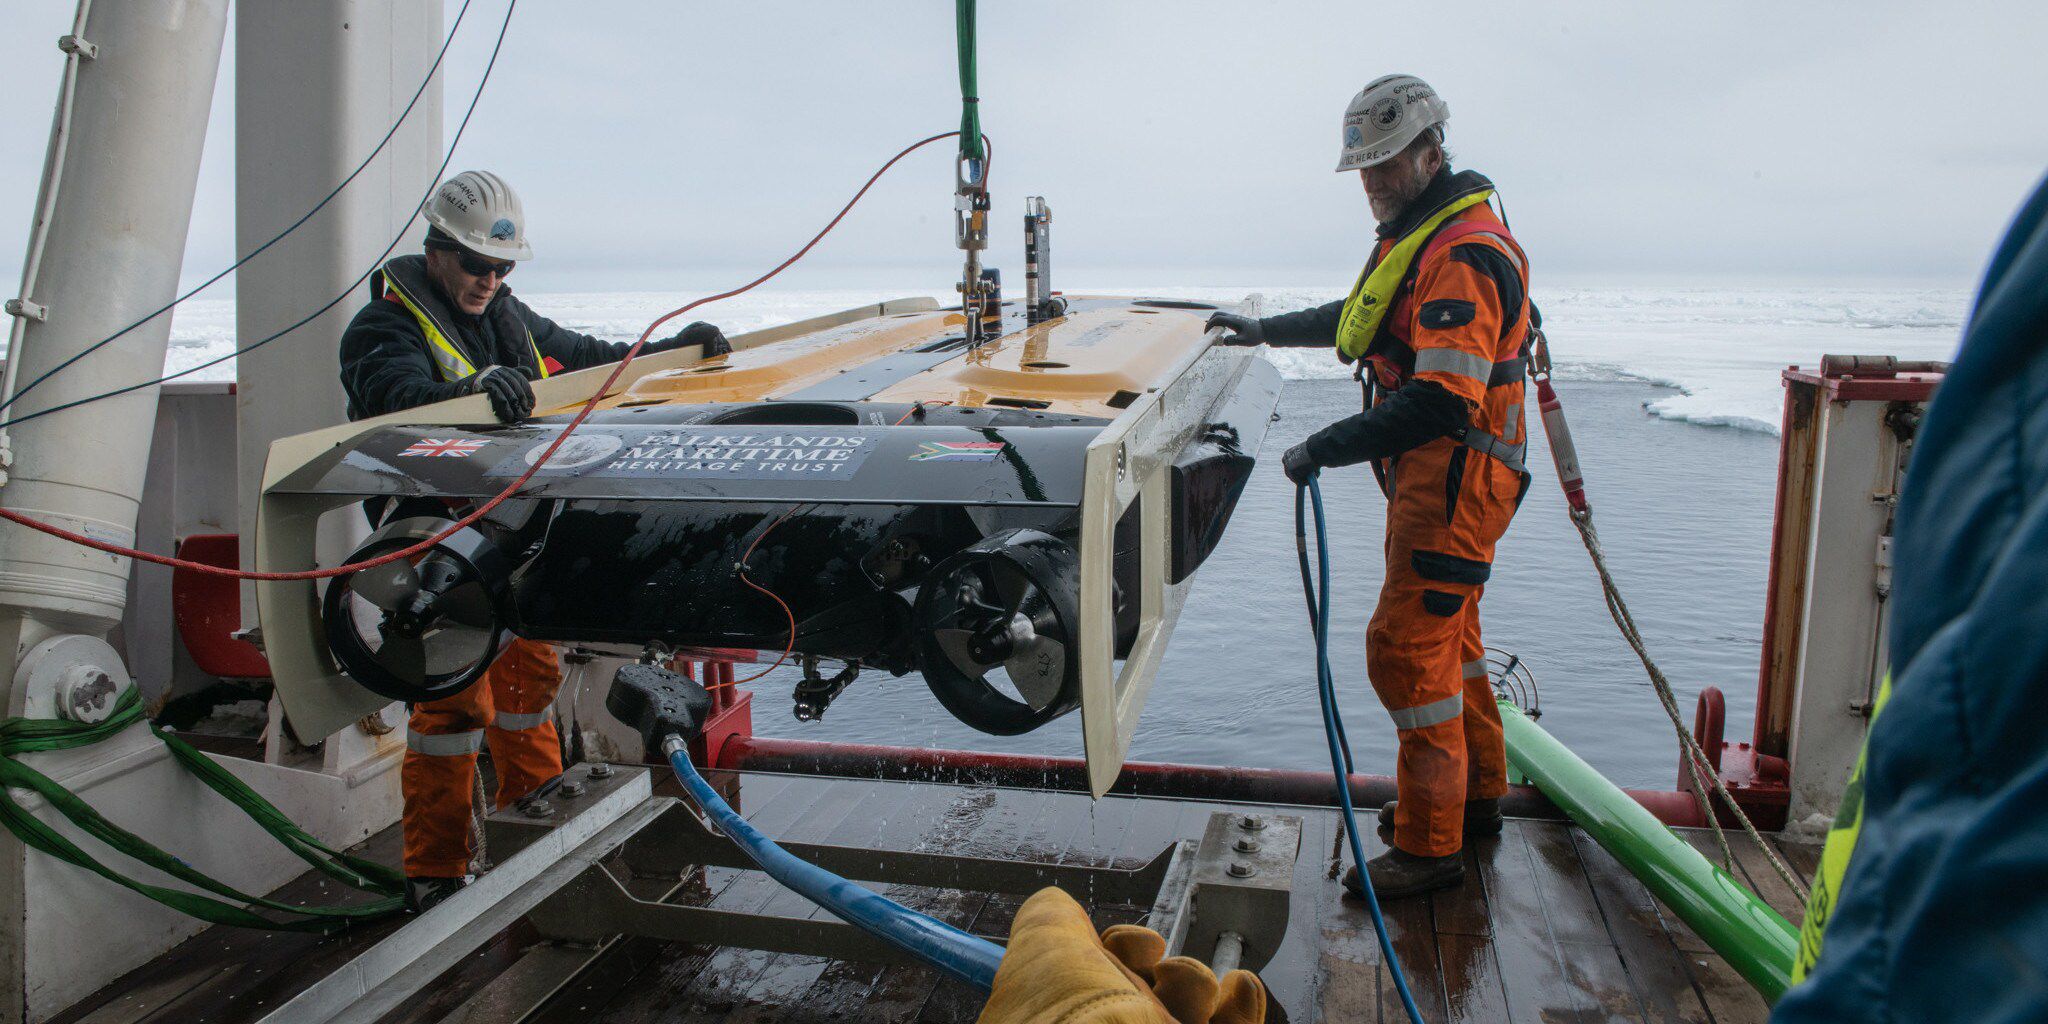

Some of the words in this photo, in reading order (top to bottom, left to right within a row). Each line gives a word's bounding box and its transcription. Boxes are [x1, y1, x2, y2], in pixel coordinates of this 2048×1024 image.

[1356, 150, 1380, 164] HERE
[639, 435, 867, 447] FALKLANDS
[621, 447, 856, 461] MARITIME
[608, 461, 745, 471] HERITAGE
[757, 463, 844, 472] TRUST
